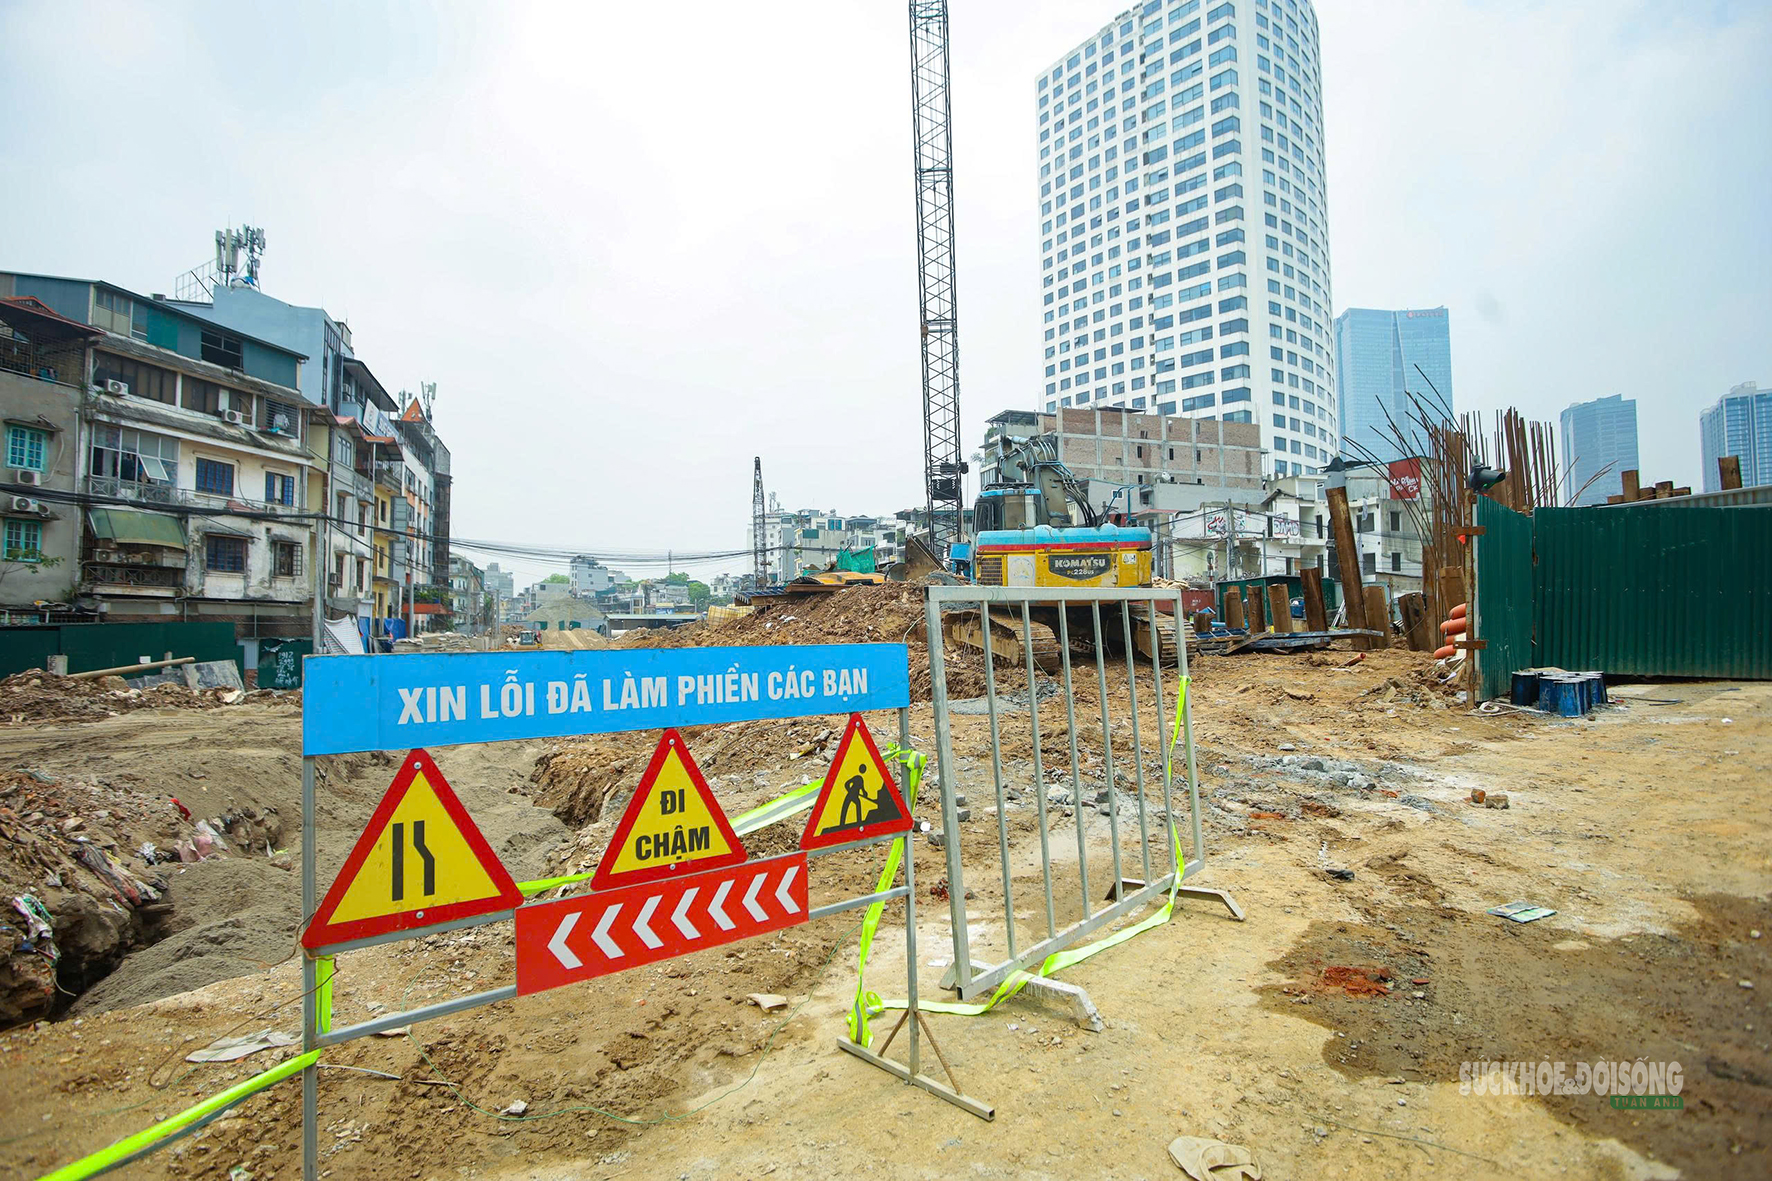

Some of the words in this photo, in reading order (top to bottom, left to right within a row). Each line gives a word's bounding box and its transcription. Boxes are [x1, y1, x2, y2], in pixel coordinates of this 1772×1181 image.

[1054, 557, 1106, 568] KOMATSU
[397, 686, 466, 725] XIN
[480, 668, 535, 719] LỖI
[545, 672, 592, 715] ĐÃ
[603, 670, 668, 711] LÀM
[677, 662, 759, 706] PHIỀN
[767, 664, 815, 701] CÁC
[822, 668, 868, 702] BẠN
[659, 788, 686, 816] ĐI
[635, 825, 710, 861] CHẬM
